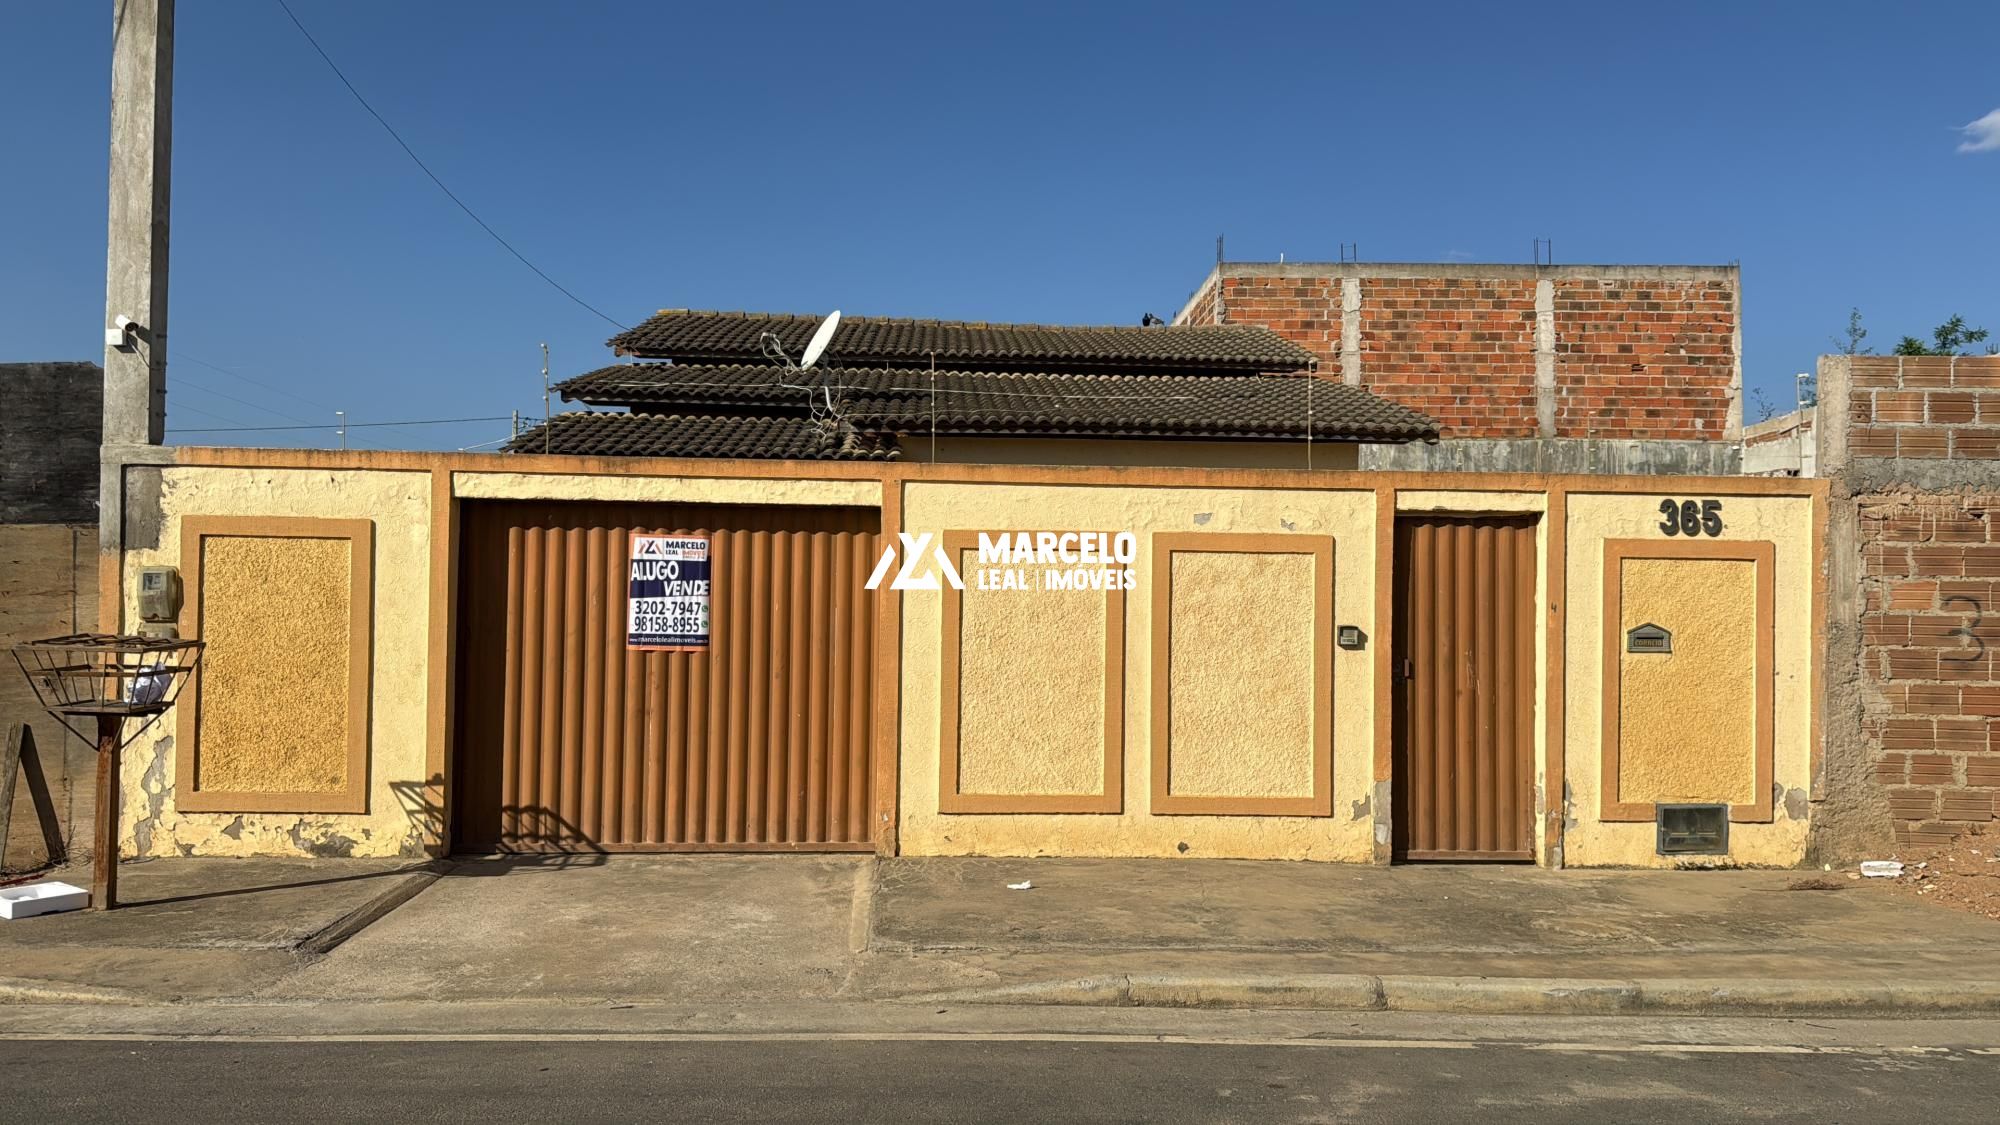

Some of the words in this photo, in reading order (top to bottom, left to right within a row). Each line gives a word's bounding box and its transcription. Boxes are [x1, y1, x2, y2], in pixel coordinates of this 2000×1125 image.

[1658, 498, 1723, 538] 365
[666, 541, 706, 550] MARCELO
[631, 561, 679, 581] ALUGO
[664, 581, 709, 596] VENDE
[635, 600, 701, 616] 3202-7947
[634, 616, 700, 633] 98158-8955
